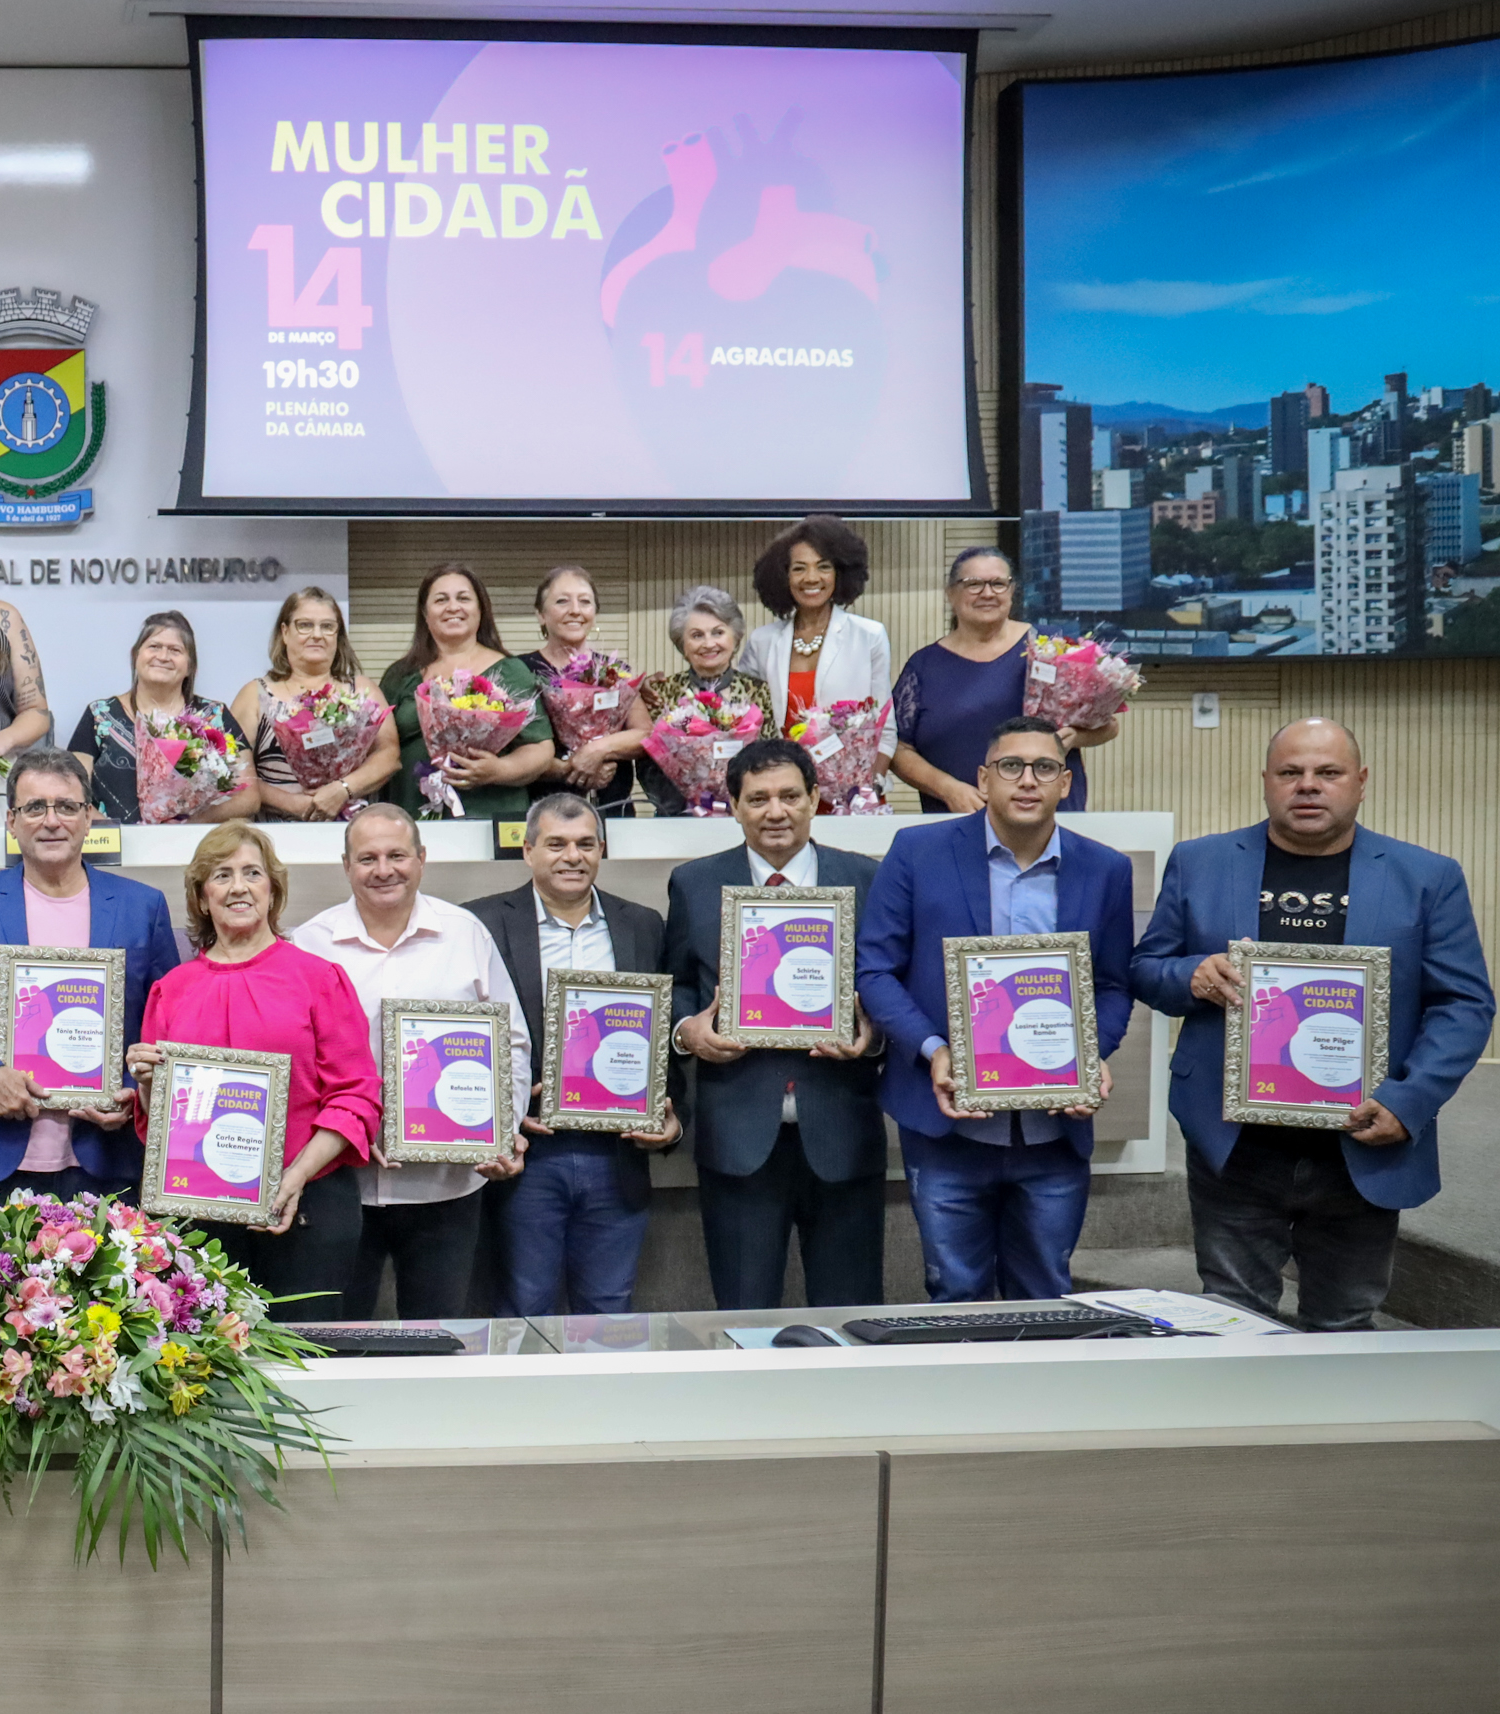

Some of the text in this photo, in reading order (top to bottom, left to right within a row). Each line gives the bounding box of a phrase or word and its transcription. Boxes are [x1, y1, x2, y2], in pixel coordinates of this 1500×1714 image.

[270, 121, 550, 175] MULHER
[320, 167, 603, 240] CIDADÃ
[247, 224, 373, 350] 14
[268, 332, 335, 347] DE MARÇO
[640, 333, 854, 388] 14 AGRACIADAS
[262, 361, 360, 389] 19h30
[265, 398, 349, 417] PLENÁRIO
[265, 418, 366, 437] DA CÂMARA
[17, 504, 76, 514] HAMBURGO
[30, 558, 61, 585] DE
[71, 557, 139, 585] NOVO
[146, 556, 282, 584] HAMBURGO
[84, 837, 109, 845] eteffi
[1280, 917, 1327, 928] HUGO
[784, 924, 828, 933] MULHER
[785, 932, 827, 943] CIDADÃ
[1014, 974, 1062, 985] MULHER
[56, 984, 99, 994] MULHER
[1016, 984, 1062, 996] CIDADÃ
[1302, 985, 1357, 998] MULHER
[57, 994, 97, 1004] CIDADÃ
[1304, 997, 1355, 1010] CIDADÃ
[604, 1008, 645, 1018] MULHER
[746, 1010, 762, 1020] 24
[605, 1018, 643, 1028] CIDADÃ
[443, 1037, 485, 1047] MULHER
[1313, 1035, 1355, 1046] Jane Pilger
[445, 1047, 484, 1057] CIDADÃ
[1319, 1043, 1345, 1052] Soares
[981, 1070, 999, 1082] 24
[1256, 1081, 1276, 1094] 24
[217, 1087, 262, 1100] MULHER
[565, 1091, 581, 1102] 24
[217, 1098, 259, 1111] CIDADÃ
[410, 1124, 426, 1135] 24
[216, 1133, 263, 1145] Carla Regina
[217, 1142, 260, 1152] Luckemeyer
[172, 1176, 188, 1188] 24
